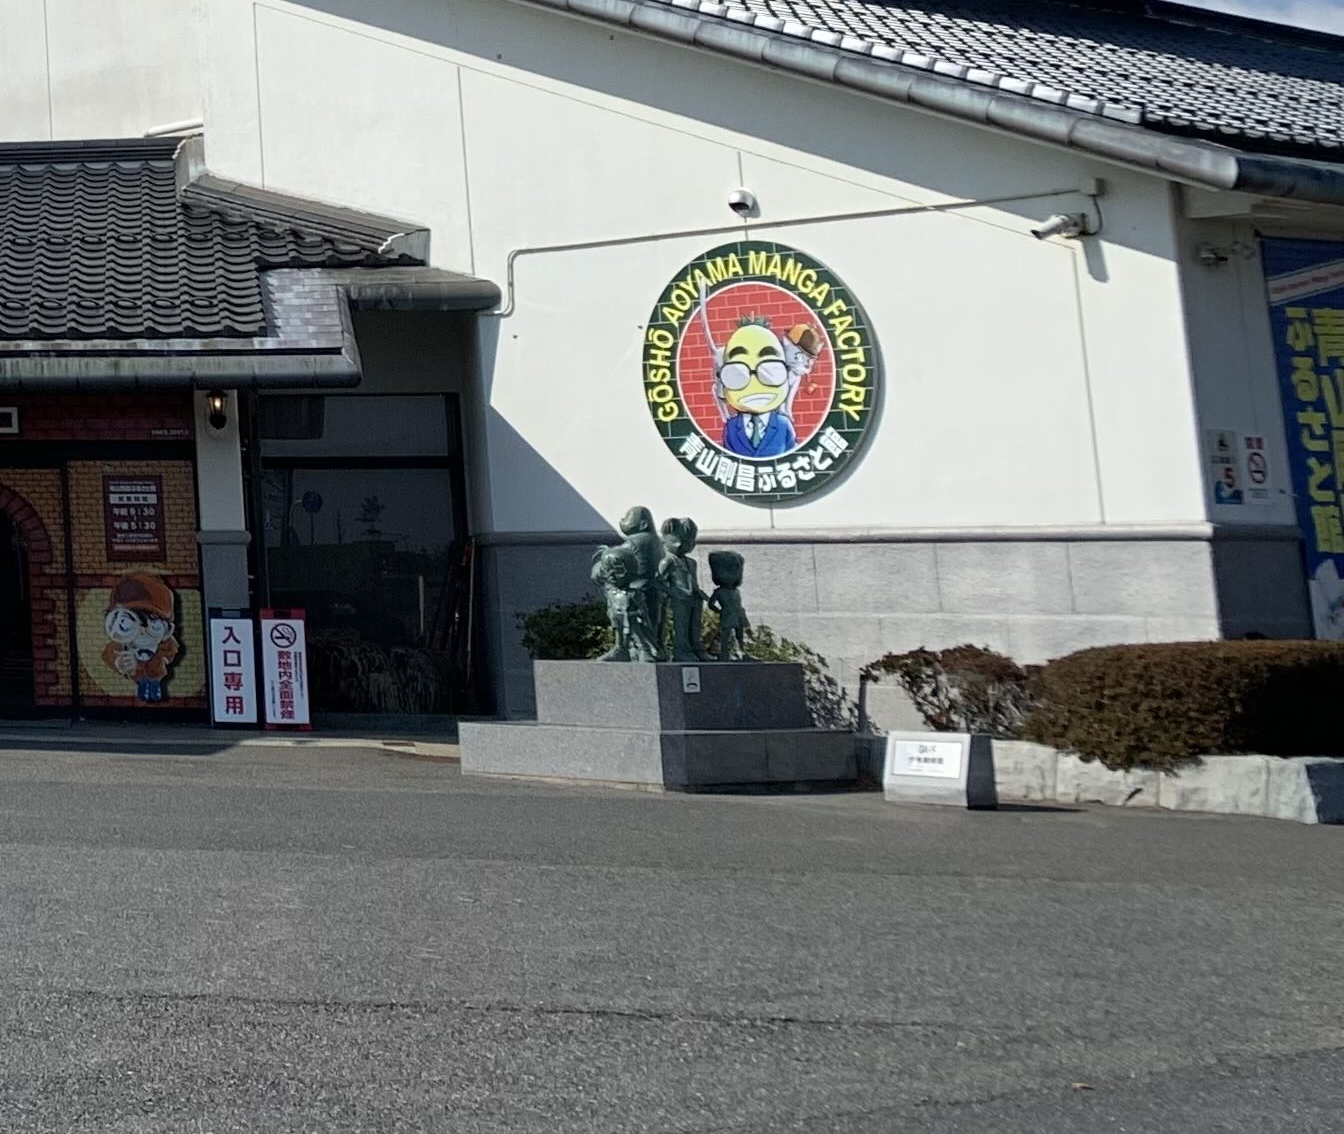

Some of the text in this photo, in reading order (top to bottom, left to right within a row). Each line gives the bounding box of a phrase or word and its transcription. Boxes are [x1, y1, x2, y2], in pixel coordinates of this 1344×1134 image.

[662, 253, 744, 327] AOYAMA
[748, 250, 833, 307] MANGA
[823, 298, 868, 422] FACTORY
[678, 426, 849, 492] 青山剛昌ふるさと館
[222, 625, 244, 716] 入口専用
